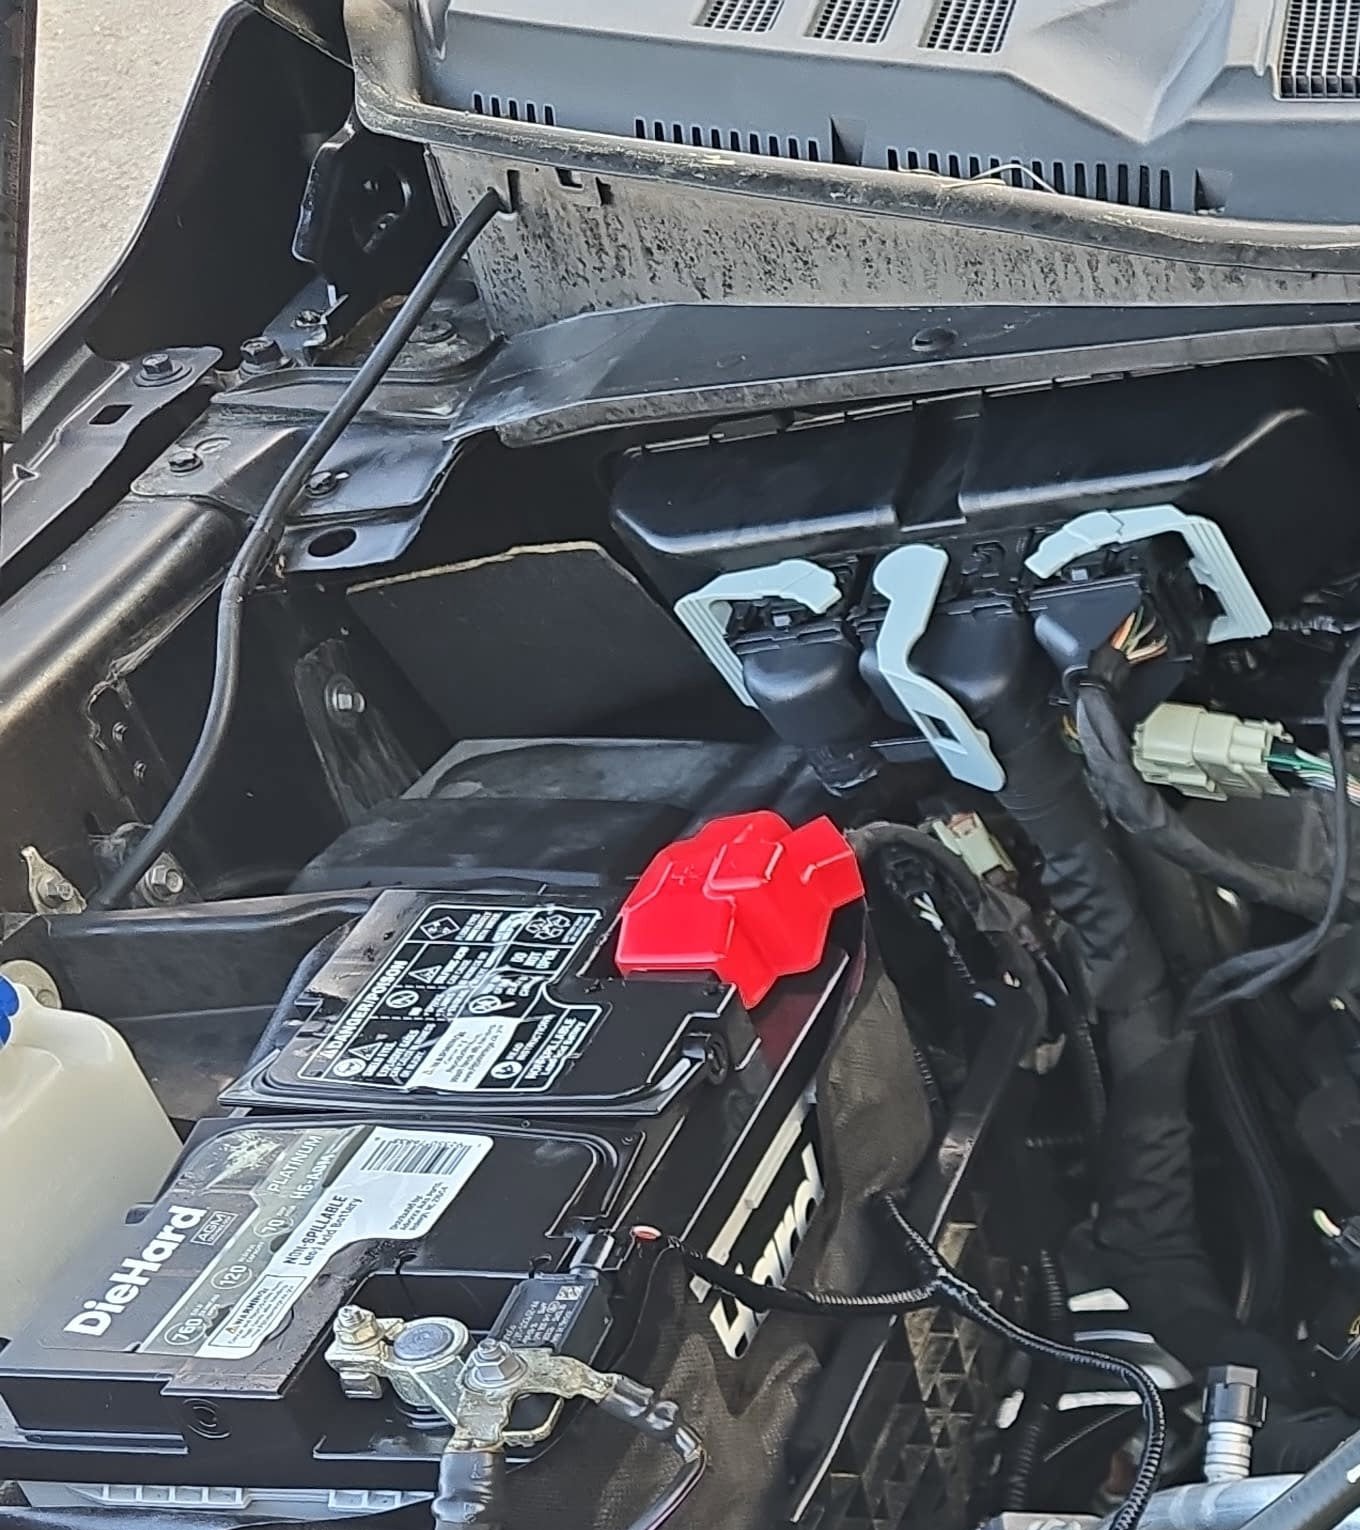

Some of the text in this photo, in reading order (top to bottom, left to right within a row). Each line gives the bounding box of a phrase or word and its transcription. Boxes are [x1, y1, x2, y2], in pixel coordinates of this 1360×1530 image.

[327, 960, 408, 1049] DANGER/POISON
[267, 1134, 323, 1194] PLATINUM
[199, 1213, 226, 1242] AGM
[261, 1218, 286, 1234] 70
[282, 1195, 349, 1264] NON-SPILLABLE
[63, 1205, 207, 1336] DieHard
[219, 1264, 249, 1286] 120
[171, 1317, 205, 1341] 760
